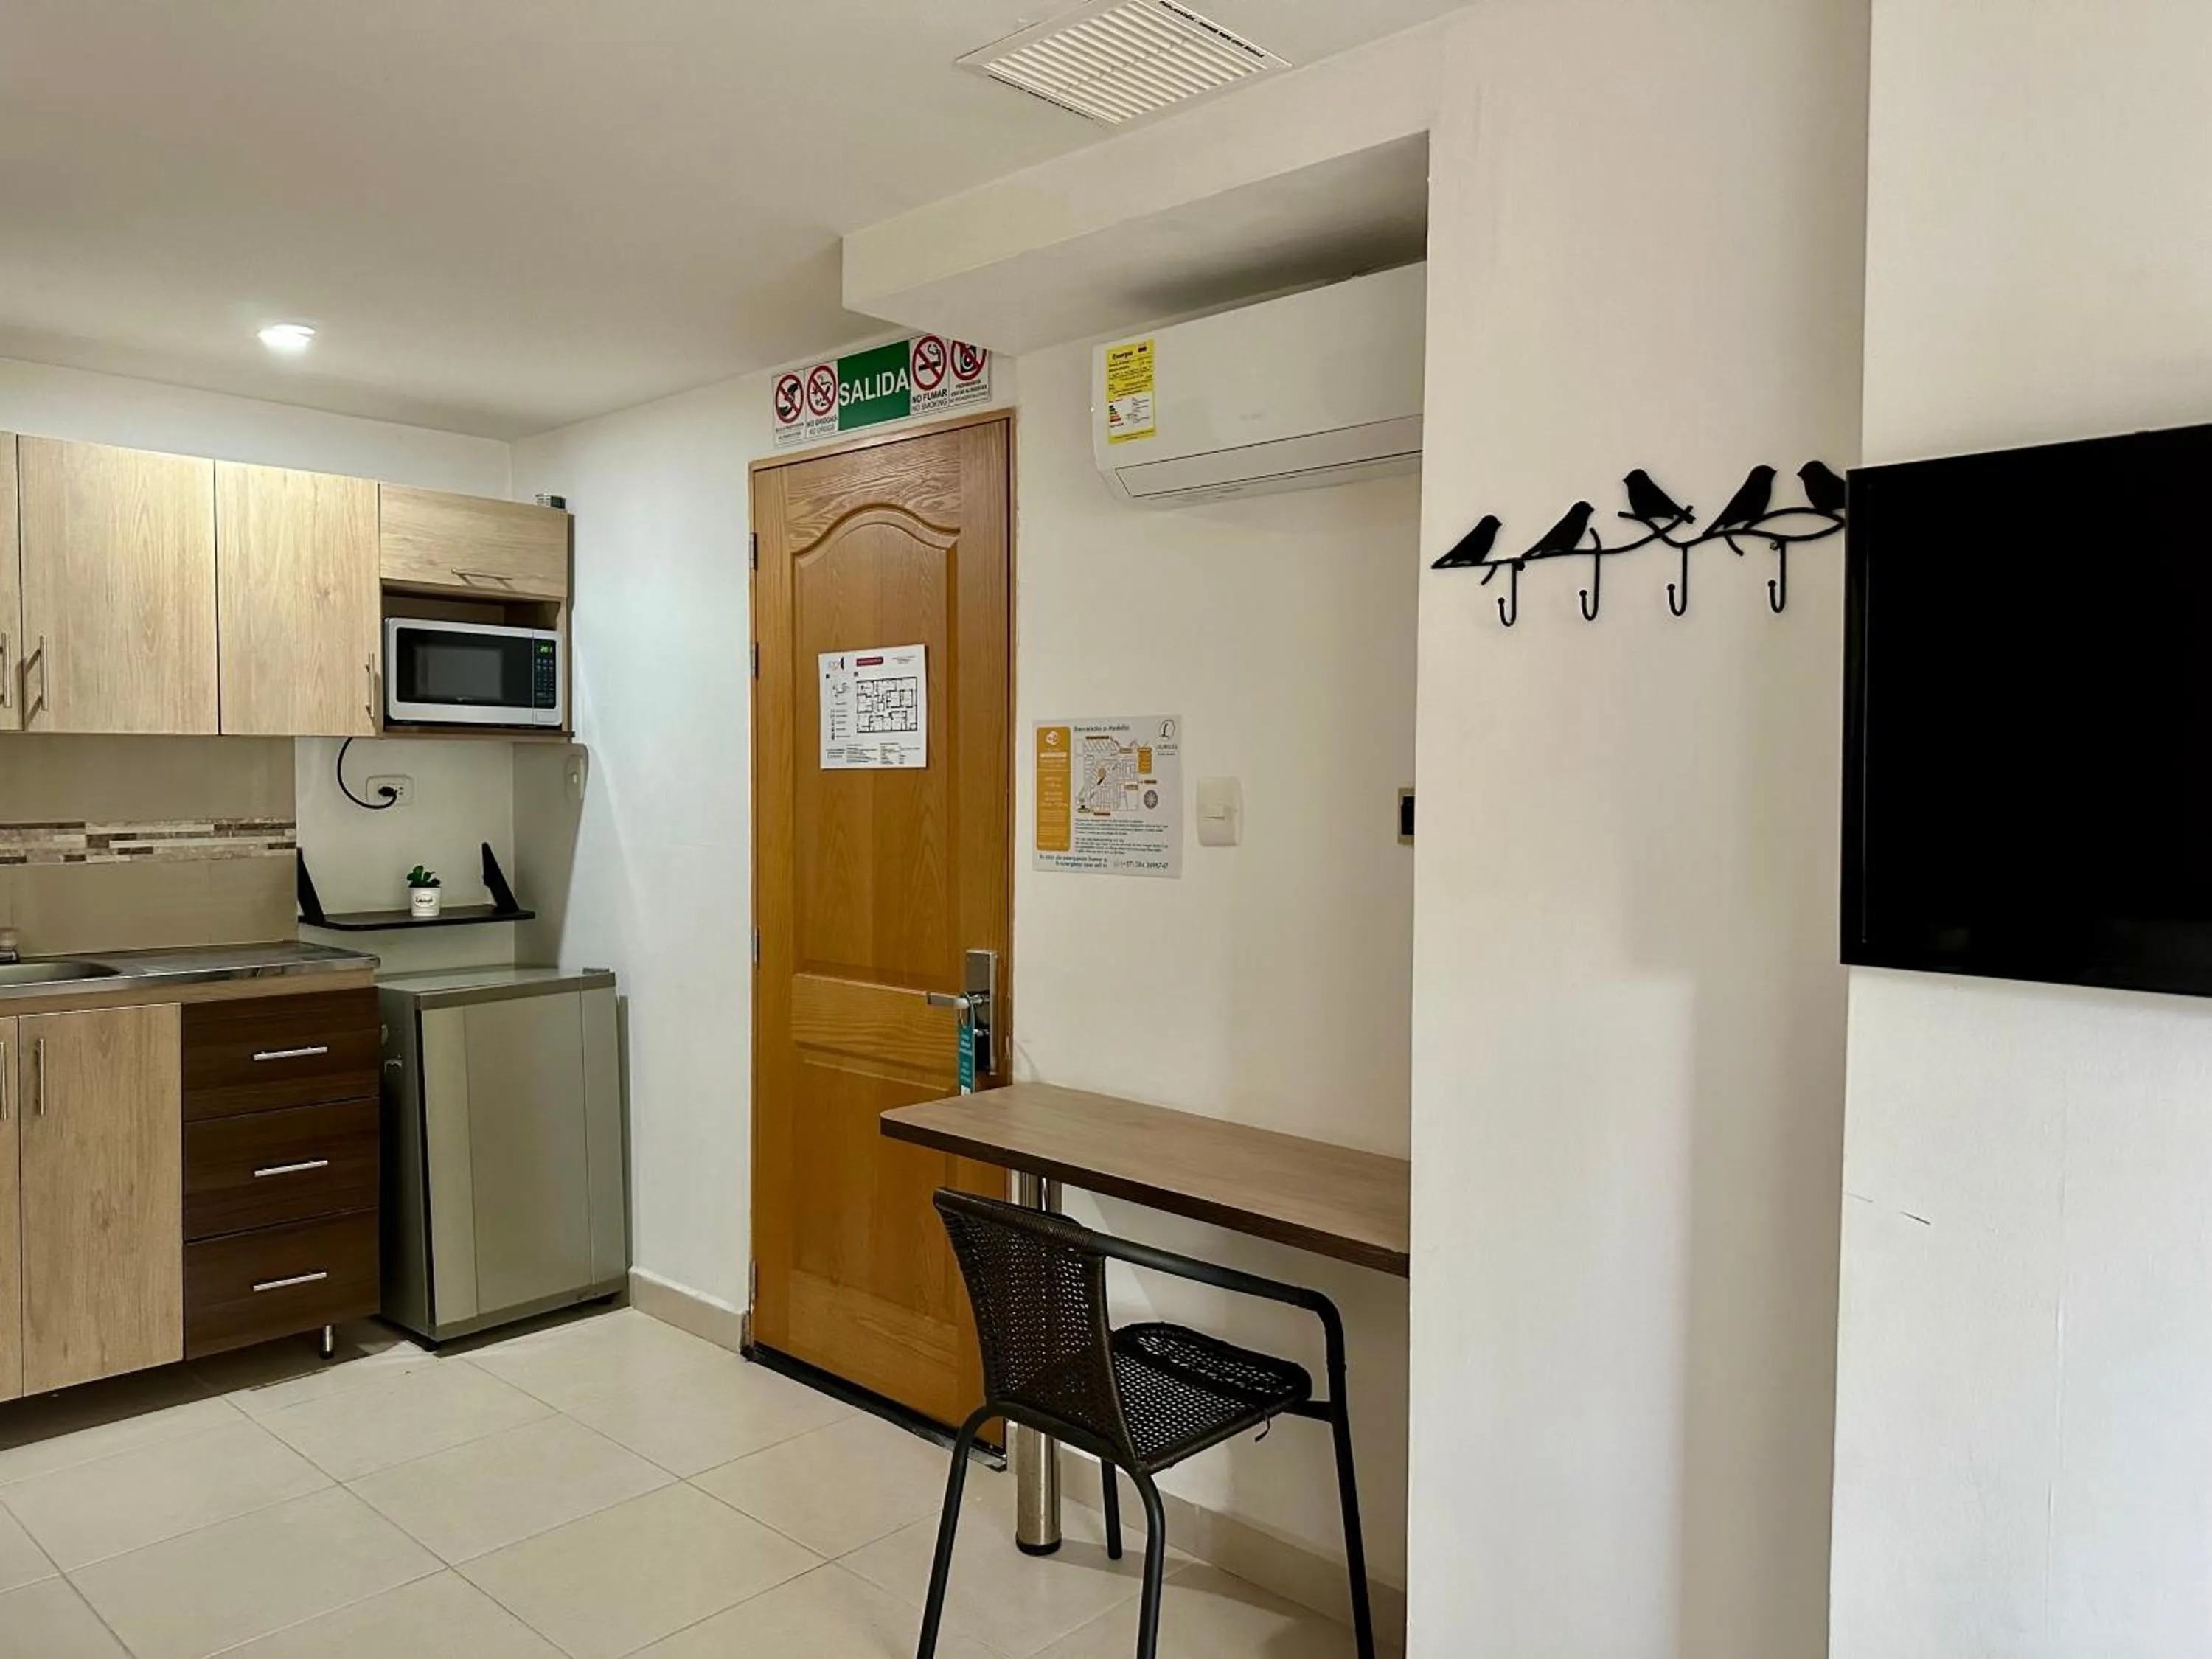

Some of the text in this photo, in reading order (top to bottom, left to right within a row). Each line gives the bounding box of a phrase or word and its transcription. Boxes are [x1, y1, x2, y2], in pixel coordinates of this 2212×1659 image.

[838, 368, 910, 406] SALIDA
[912, 394, 922, 403] NO
[923, 389, 947, 400] FUMAR
[913, 397, 947, 411] NO SMOKING
